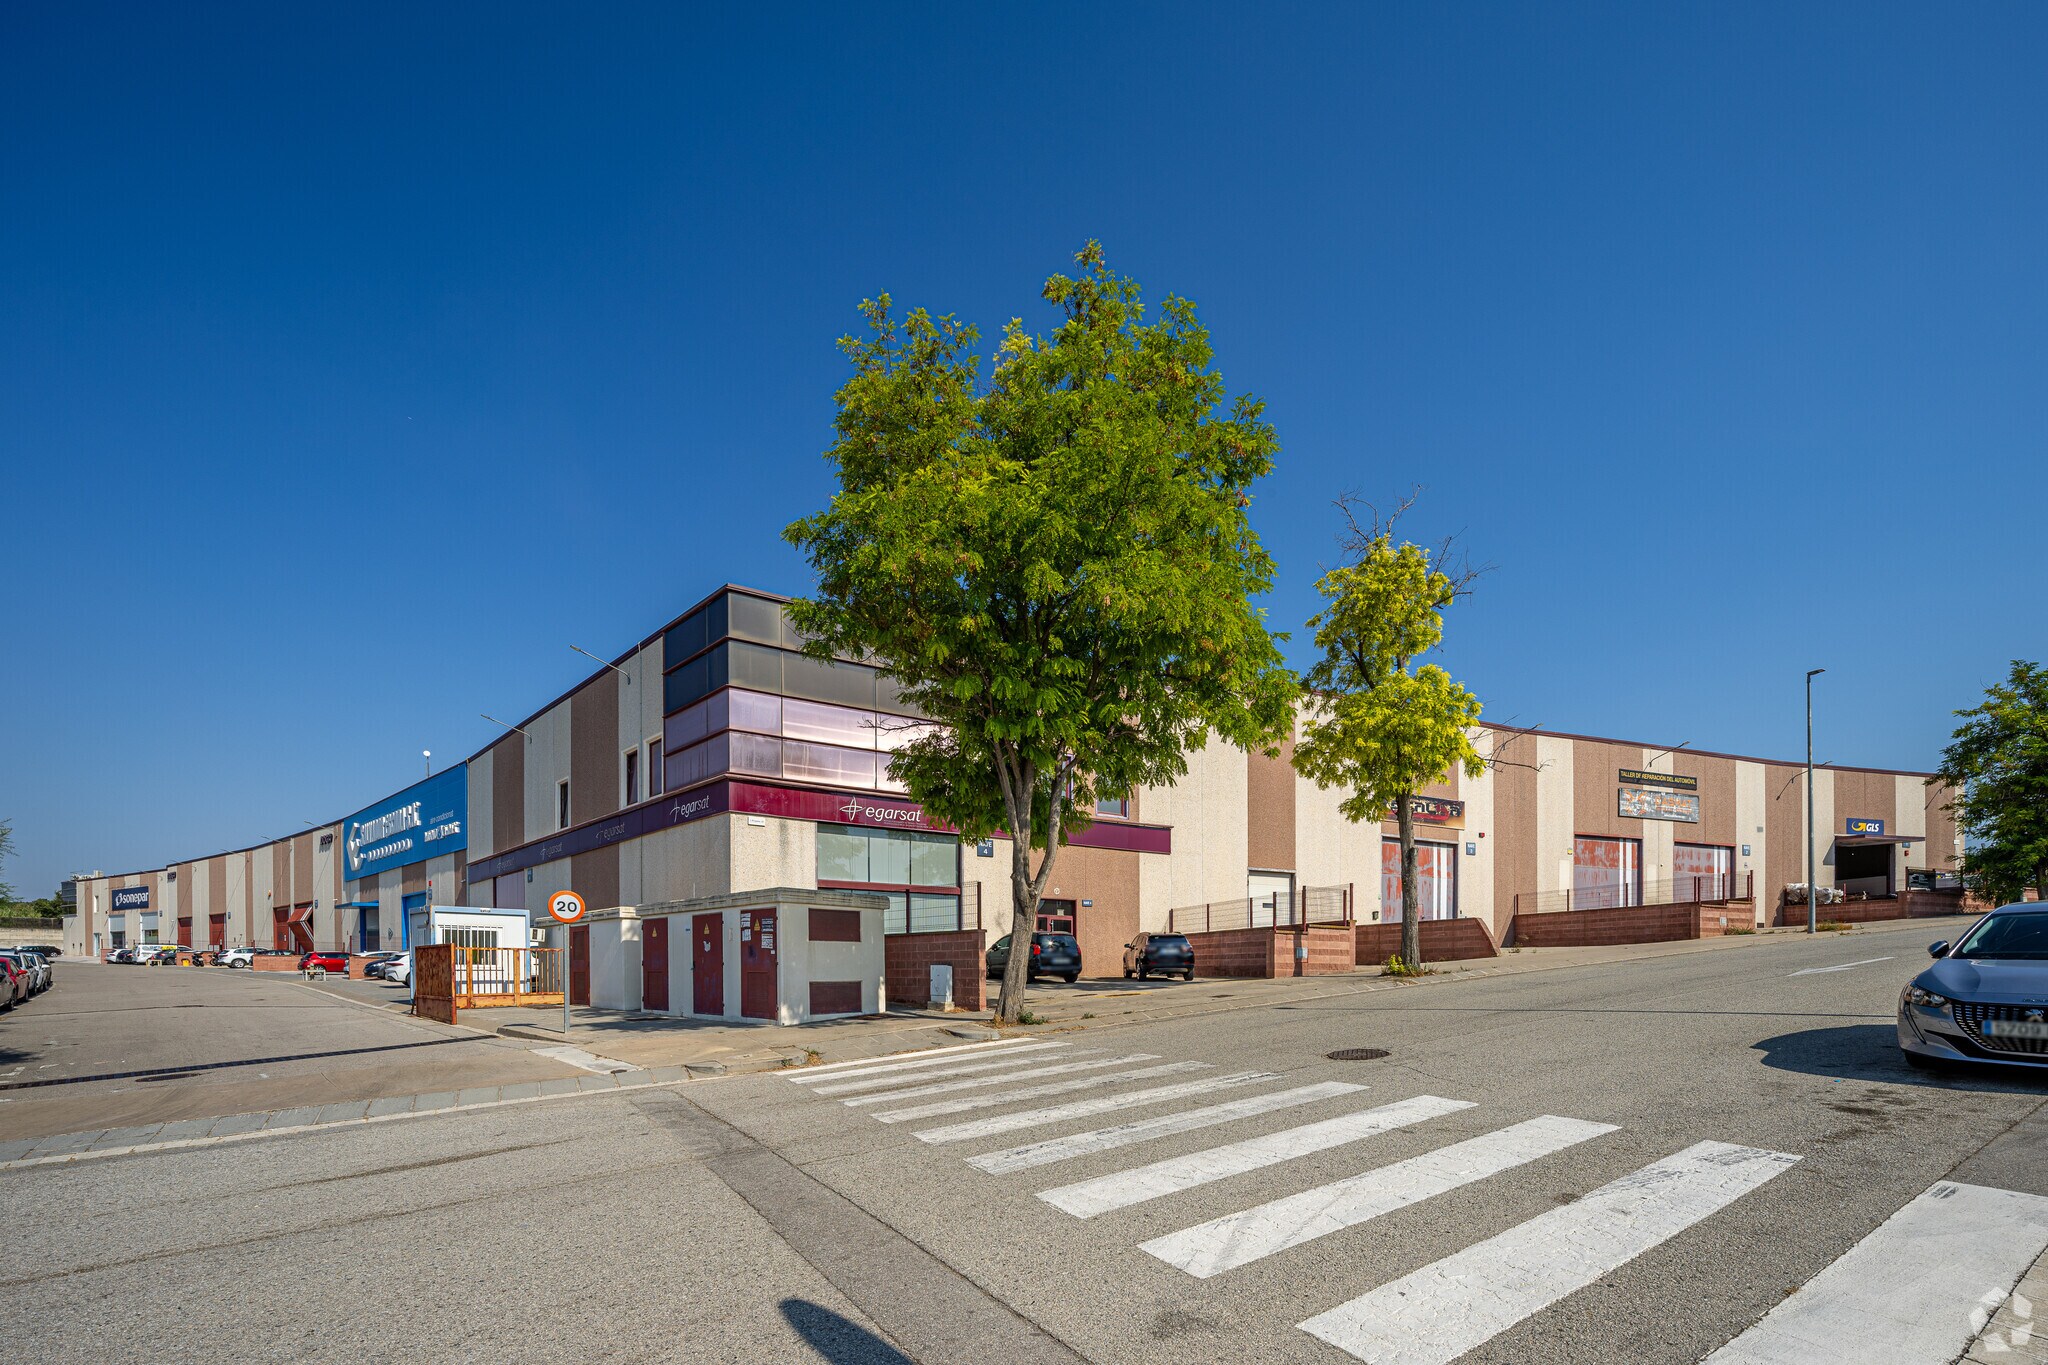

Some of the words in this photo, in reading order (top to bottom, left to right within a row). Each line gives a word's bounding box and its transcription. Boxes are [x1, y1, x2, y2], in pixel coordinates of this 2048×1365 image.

[1621, 770, 1635, 778] TALLER
[1642, 772, 1666, 781] REPARACIÓN
[1675, 777, 1696, 785] AUTOMÓVIL
[680, 795, 710, 818] egarsat
[865, 806, 922, 822] egarsat
[603, 822, 625, 841] egarsat
[1866, 823, 1880, 832] GLS
[122, 892, 149, 905] sonepar
[556, 900, 578, 913] 20
